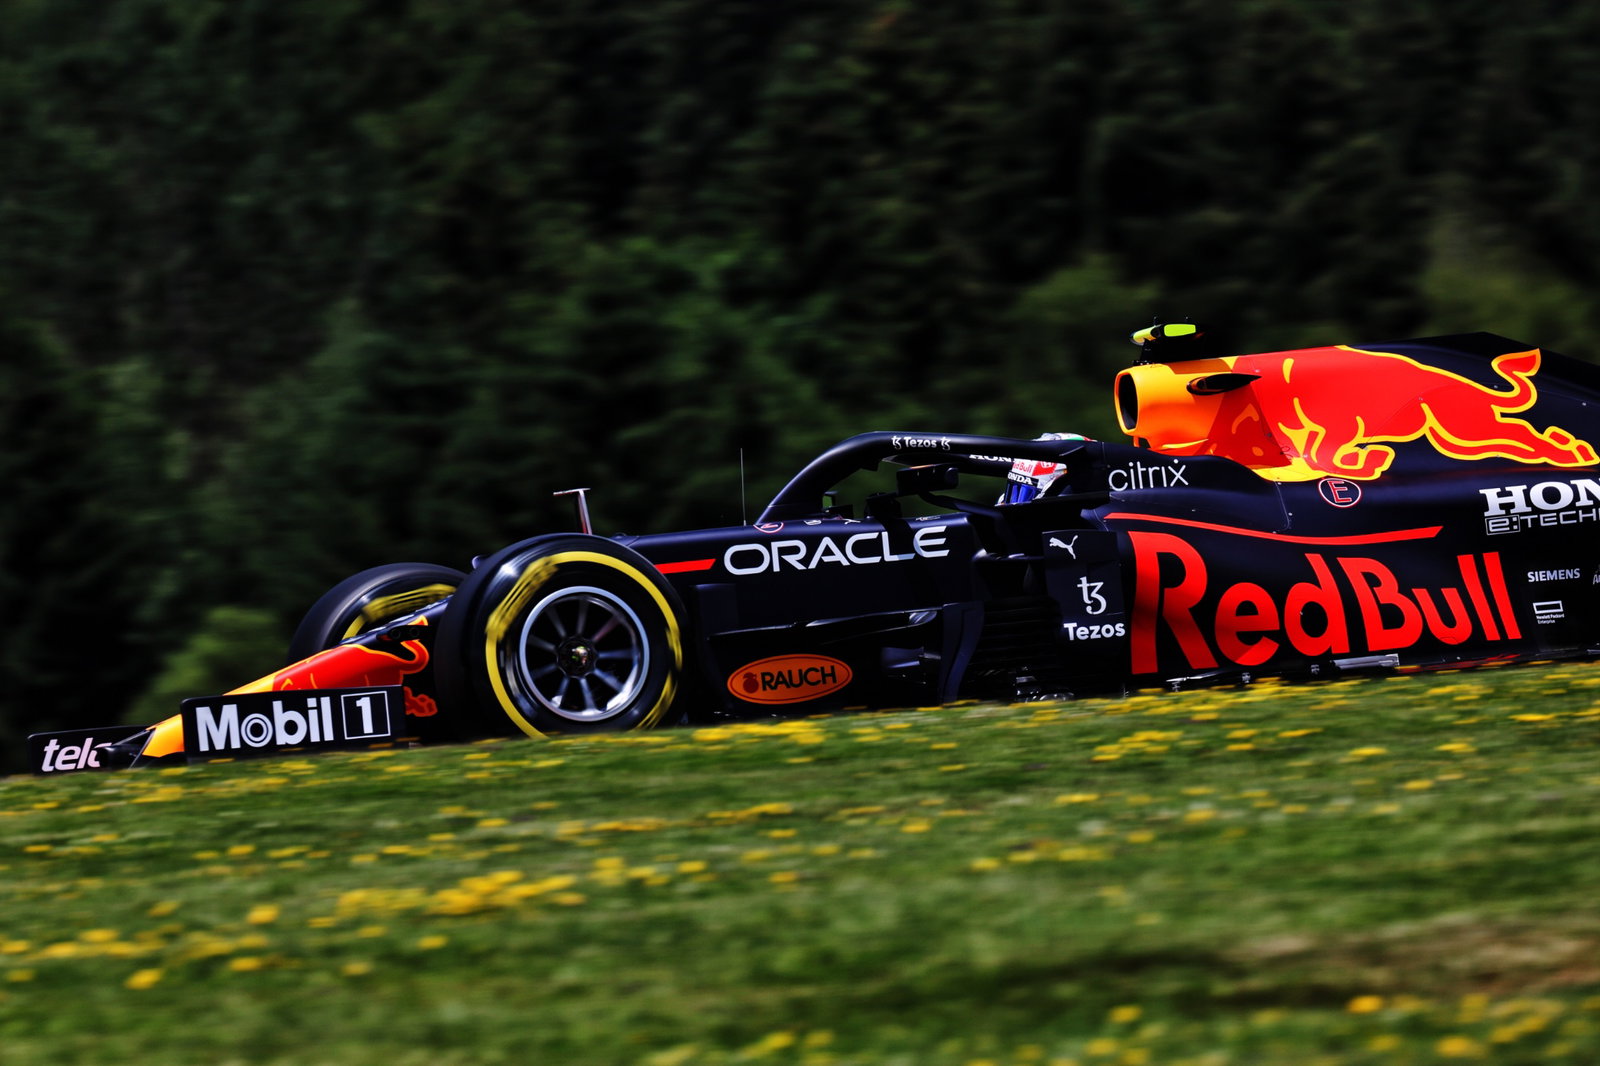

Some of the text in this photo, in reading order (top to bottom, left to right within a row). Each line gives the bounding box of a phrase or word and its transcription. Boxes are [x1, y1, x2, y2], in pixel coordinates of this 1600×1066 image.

[903, 436, 937, 448] Tezos
[1108, 459, 1189, 491] citrix
[1327, 480, 1352, 503] E
[1488, 508, 1600, 533] e:TECH
[723, 525, 950, 576] ORACLE
[1527, 568, 1580, 582] SIEMENS
[1063, 622, 1126, 641] Tezos
[761, 665, 837, 691] RAUCH
[195, 696, 374, 752] Mobil 1
